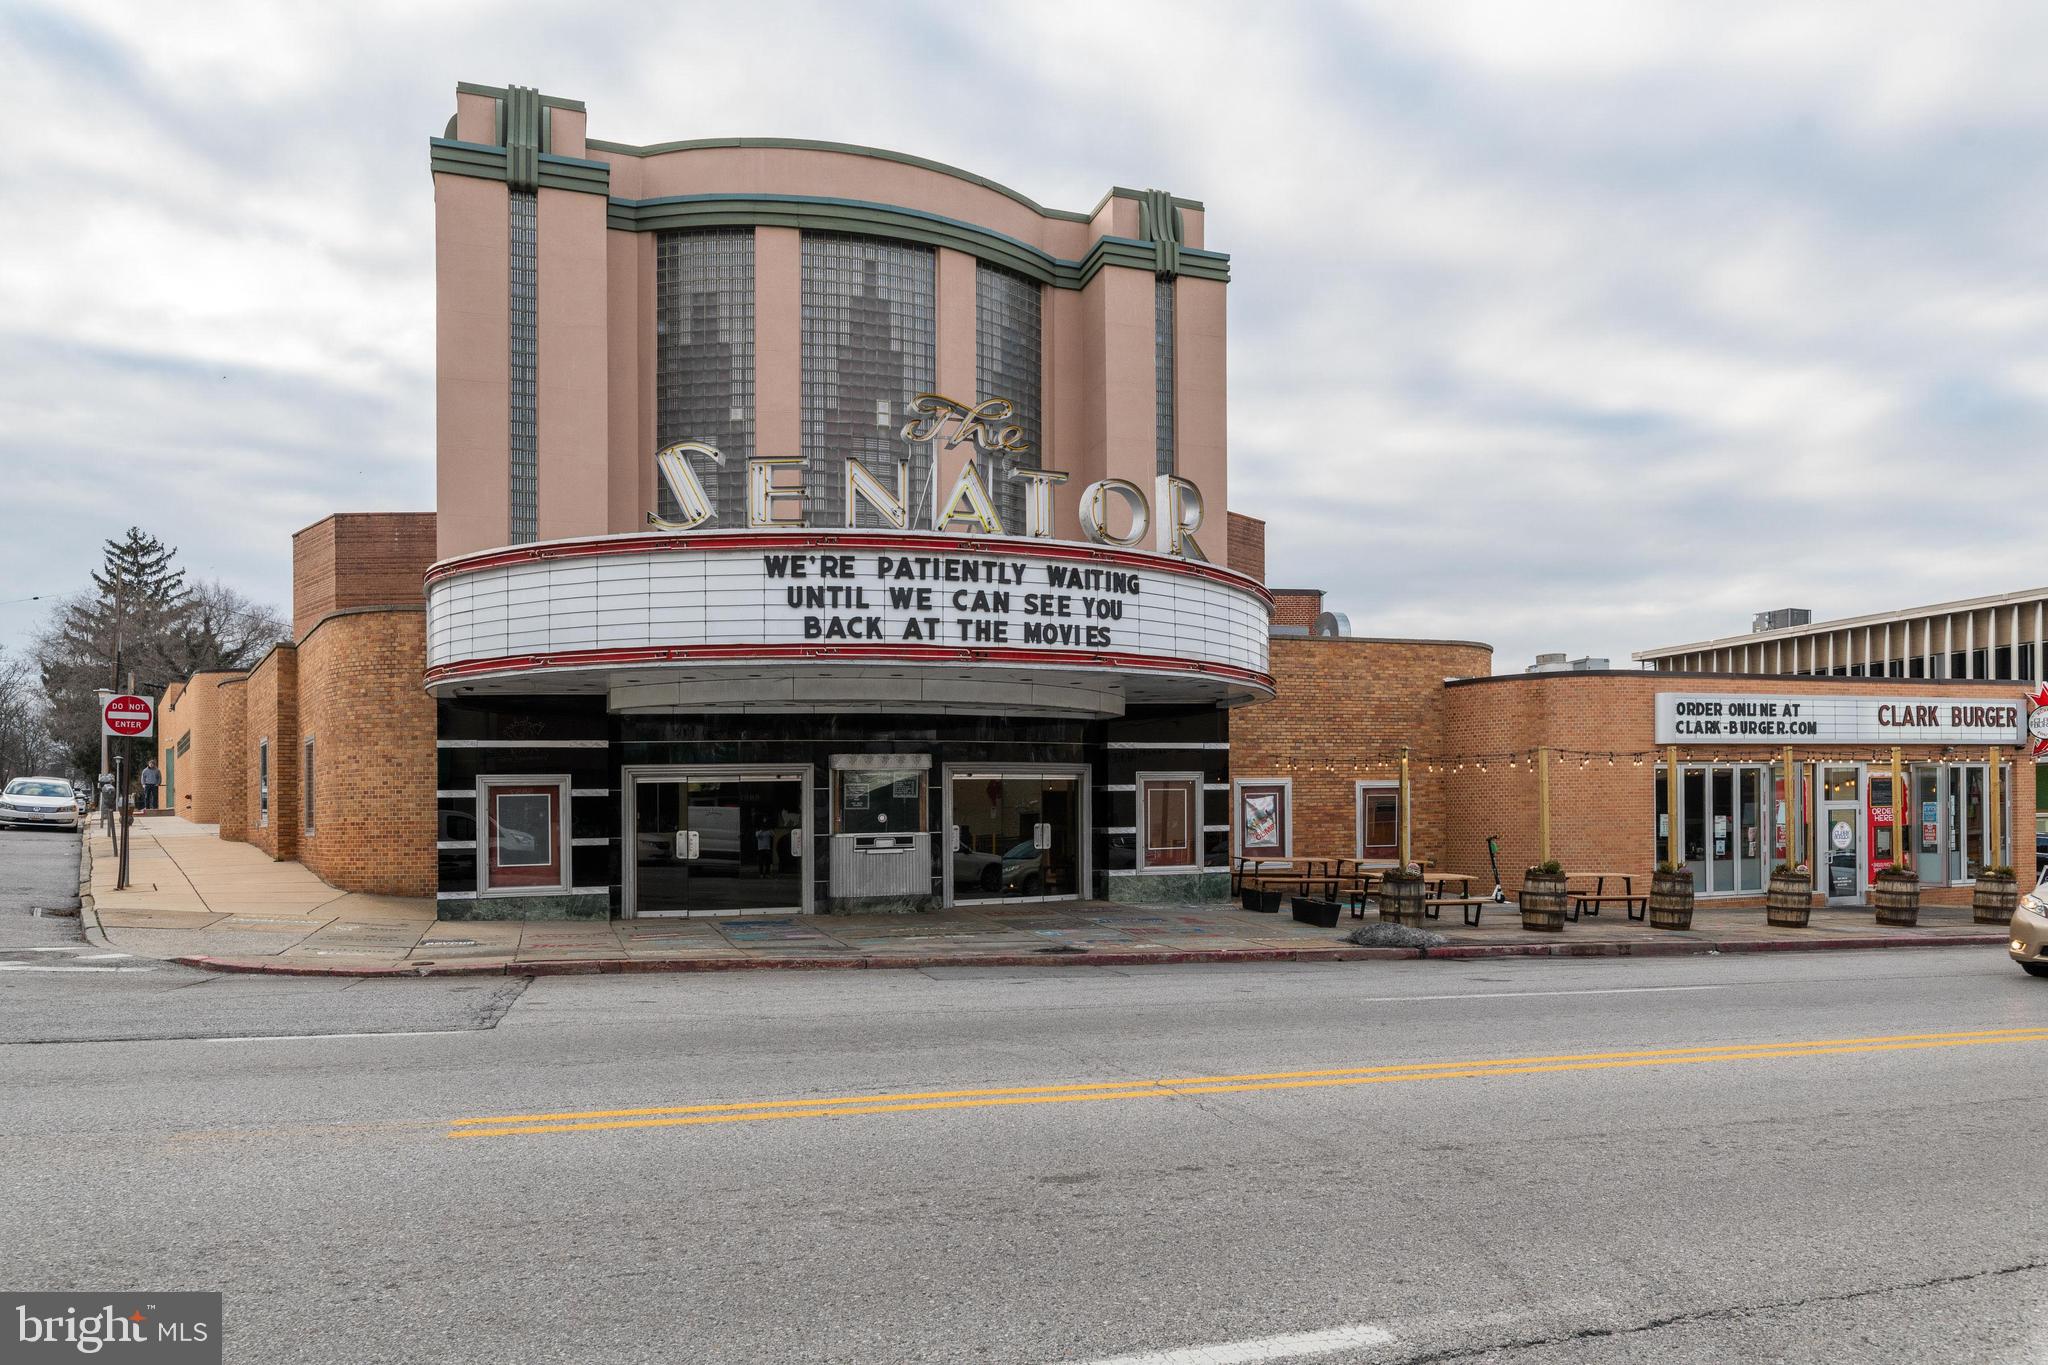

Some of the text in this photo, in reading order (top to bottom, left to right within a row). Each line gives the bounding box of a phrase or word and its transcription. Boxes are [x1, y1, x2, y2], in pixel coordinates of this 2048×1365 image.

[900, 392, 1030, 453] The
[647, 439, 1209, 562] SENATOR
[763, 555, 1142, 594] WE'RE PATIENTLY WAITING
[787, 585, 1122, 620] UNTIL WE CAN SEE YOU
[805, 617, 1110, 647] BACK AT THE MOVIES
[1676, 702, 1800, 716] ORDER ONLINE AT
[1878, 704, 1939, 726] CLARK
[1951, 706, 2017, 727] BURGER
